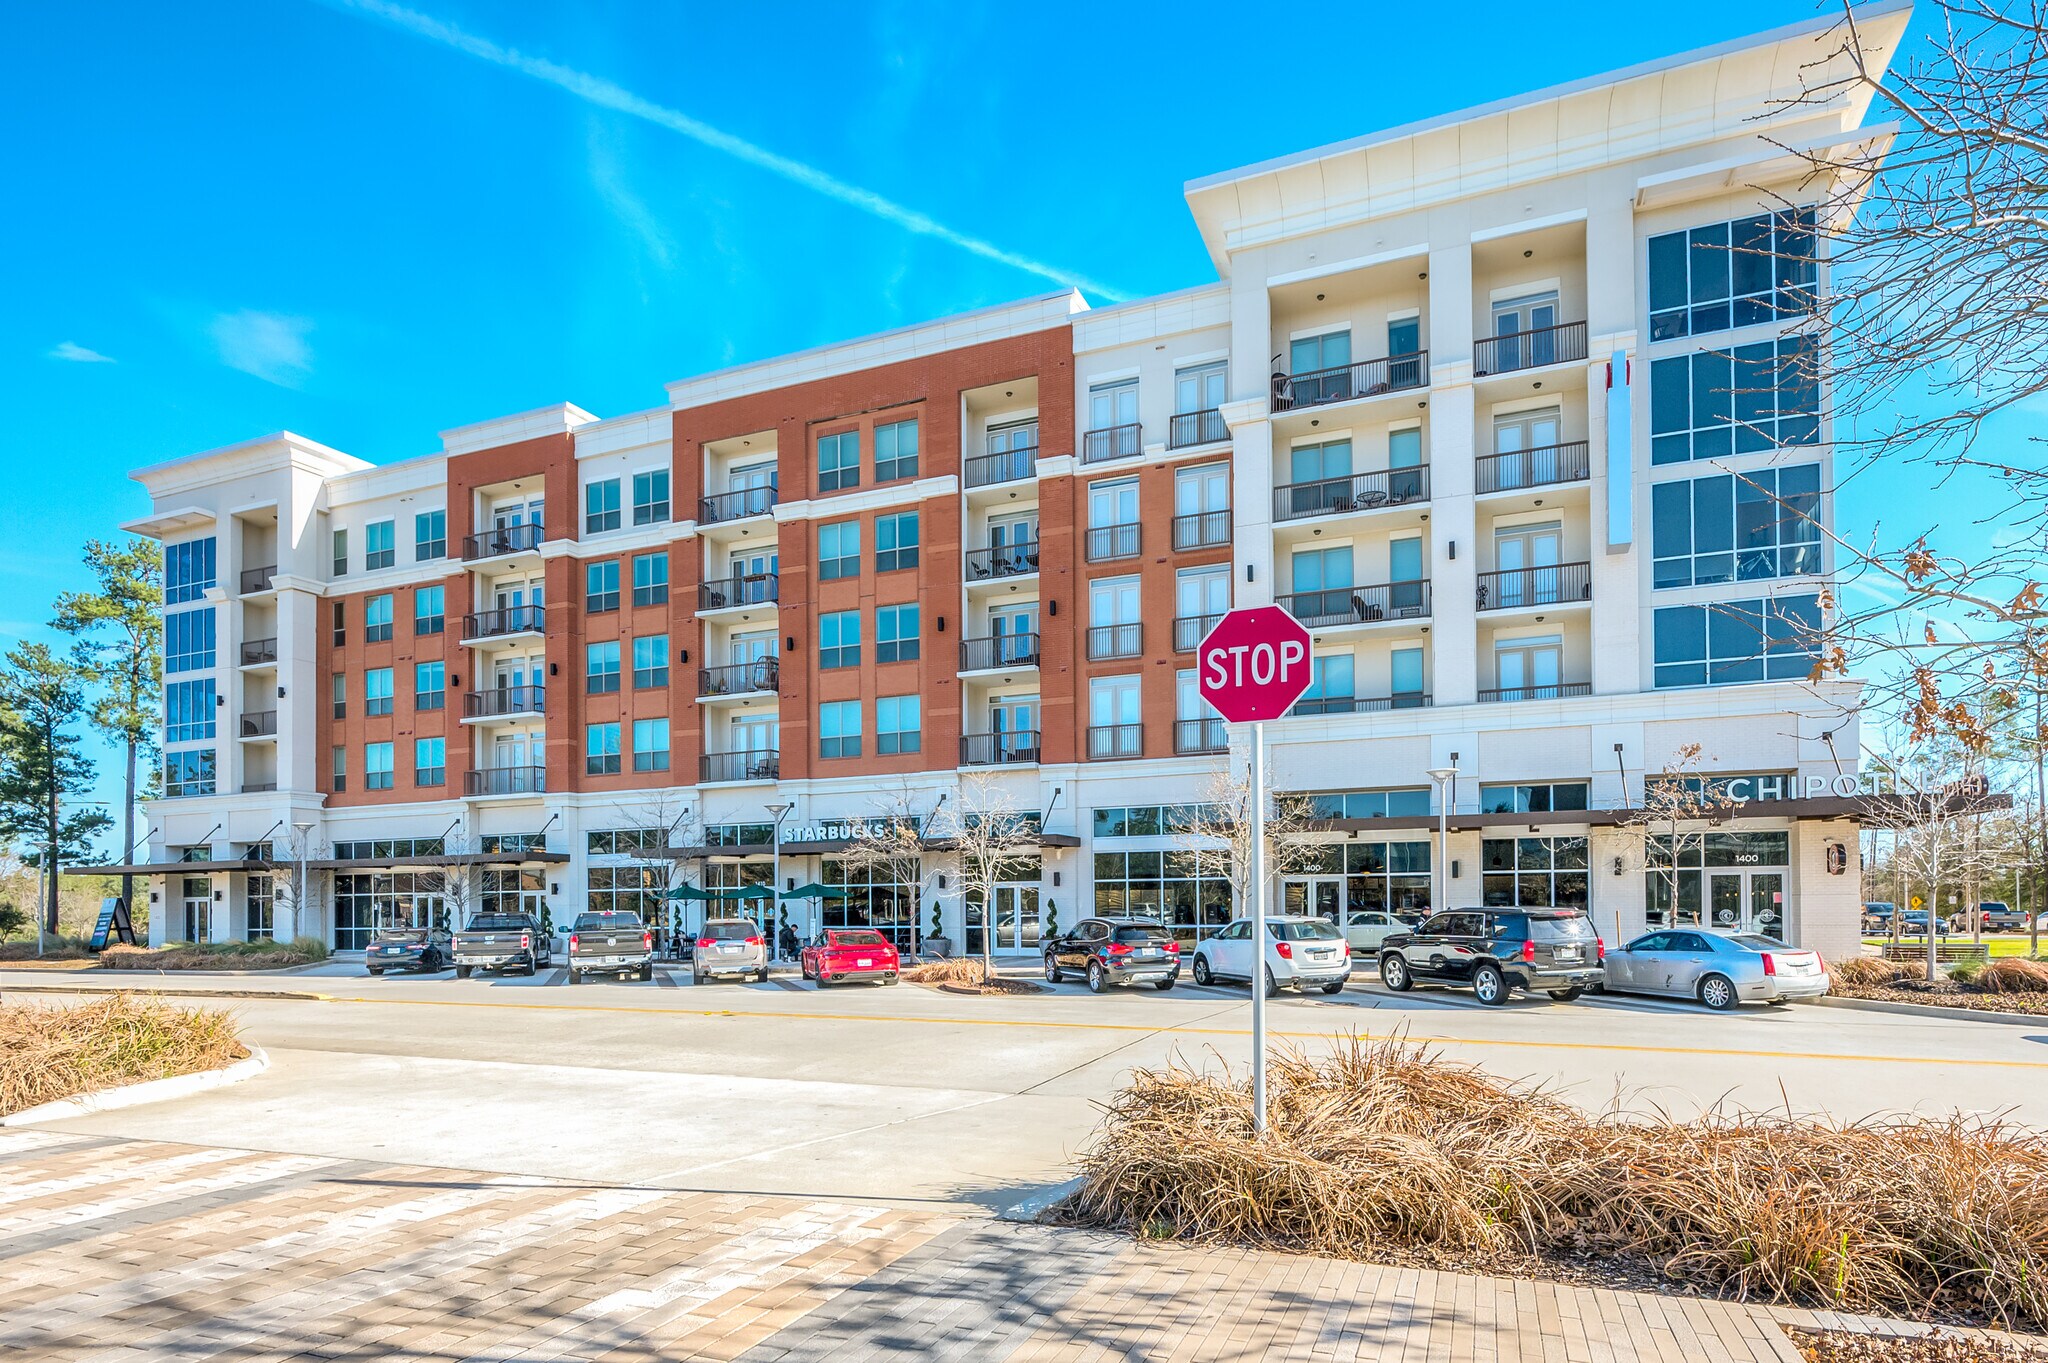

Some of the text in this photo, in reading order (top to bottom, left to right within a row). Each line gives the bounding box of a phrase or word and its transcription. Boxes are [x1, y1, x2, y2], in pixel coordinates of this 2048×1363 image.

[1205, 640, 1304, 690] STOP
[1727, 770, 1944, 802] CHIPOTLE
[784, 822, 885, 842] STARBUCKS
[1735, 854, 1759, 863] 1400
